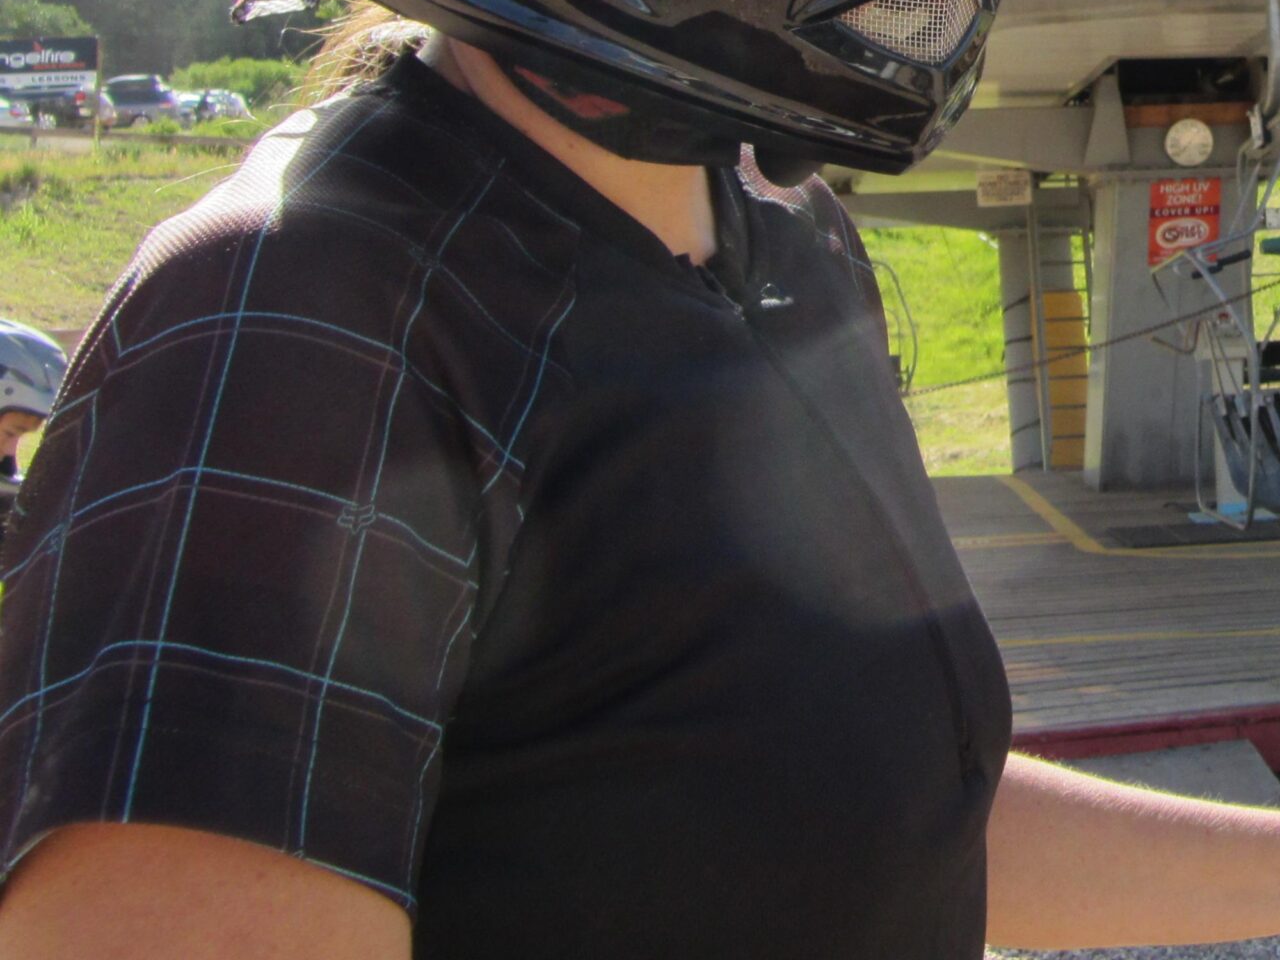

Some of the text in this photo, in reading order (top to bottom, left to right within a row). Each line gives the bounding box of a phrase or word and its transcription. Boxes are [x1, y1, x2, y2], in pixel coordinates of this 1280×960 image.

[0, 48, 75, 69] ngelfire
[1160, 182, 1210, 194] HIGH UV
[1154, 207, 1191, 217] COVER
